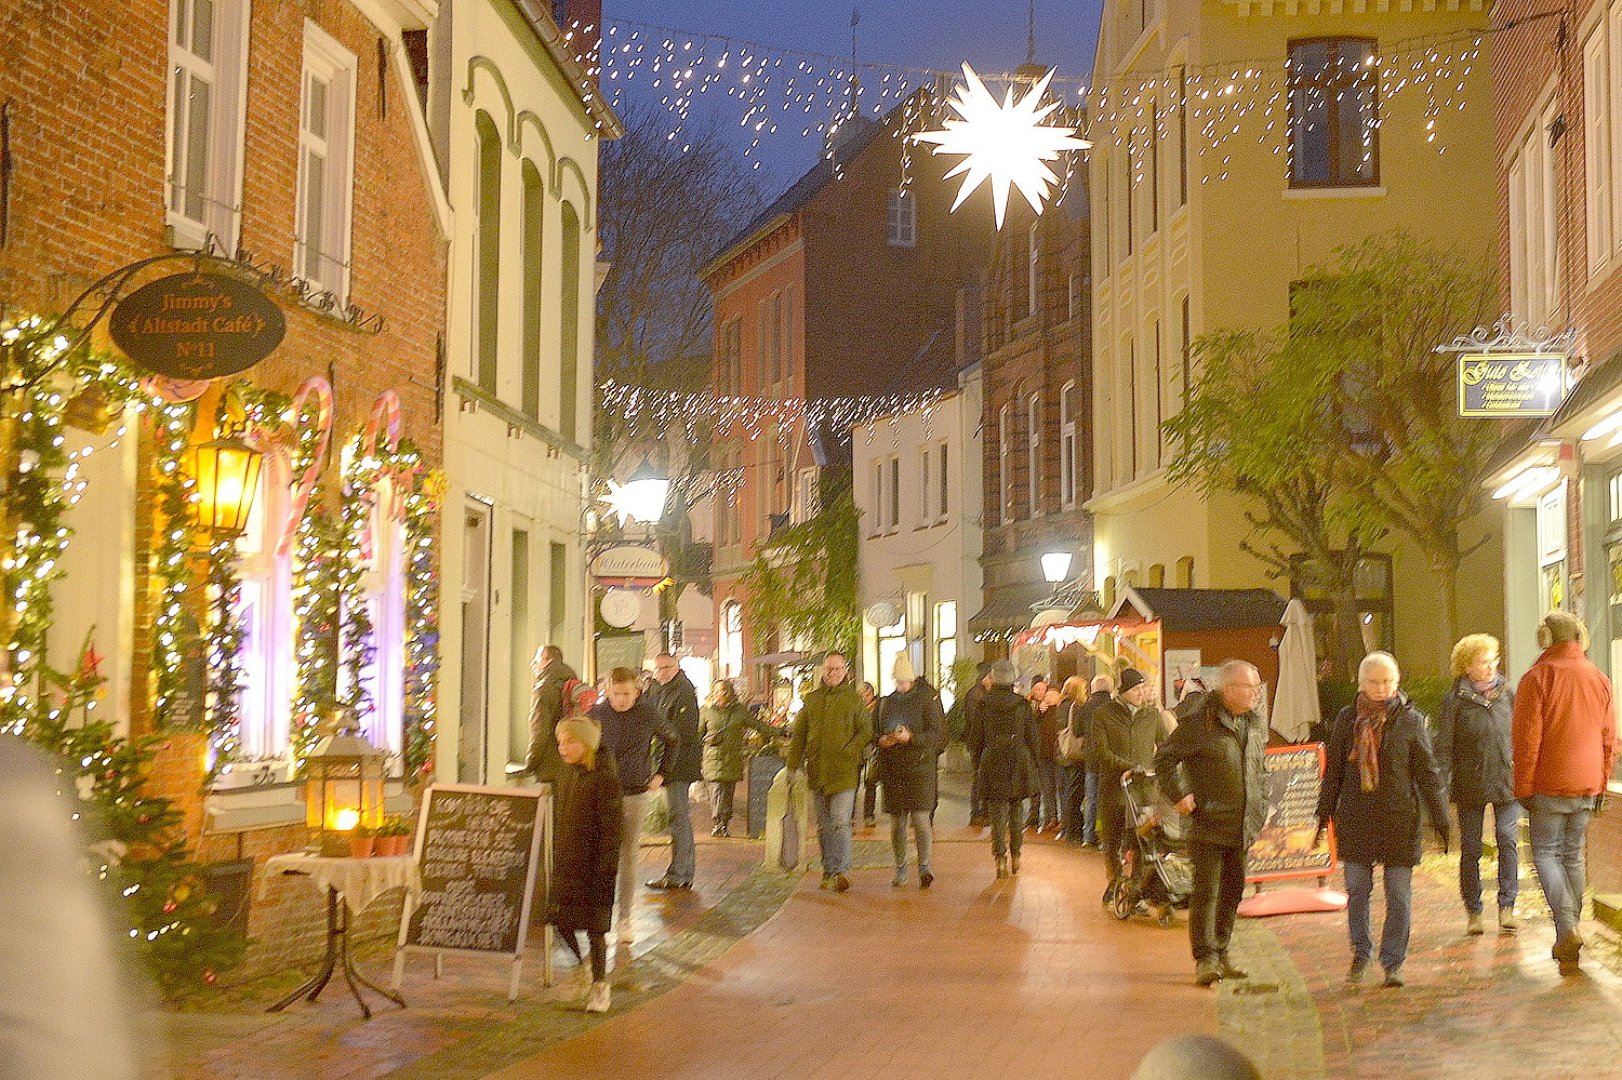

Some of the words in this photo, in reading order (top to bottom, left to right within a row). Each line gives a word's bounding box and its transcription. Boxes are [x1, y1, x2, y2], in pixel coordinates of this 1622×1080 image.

[162, 294, 232, 312] Jimmy's
[142, 317, 209, 333] Altstadt
[212, 315, 252, 333] Café
